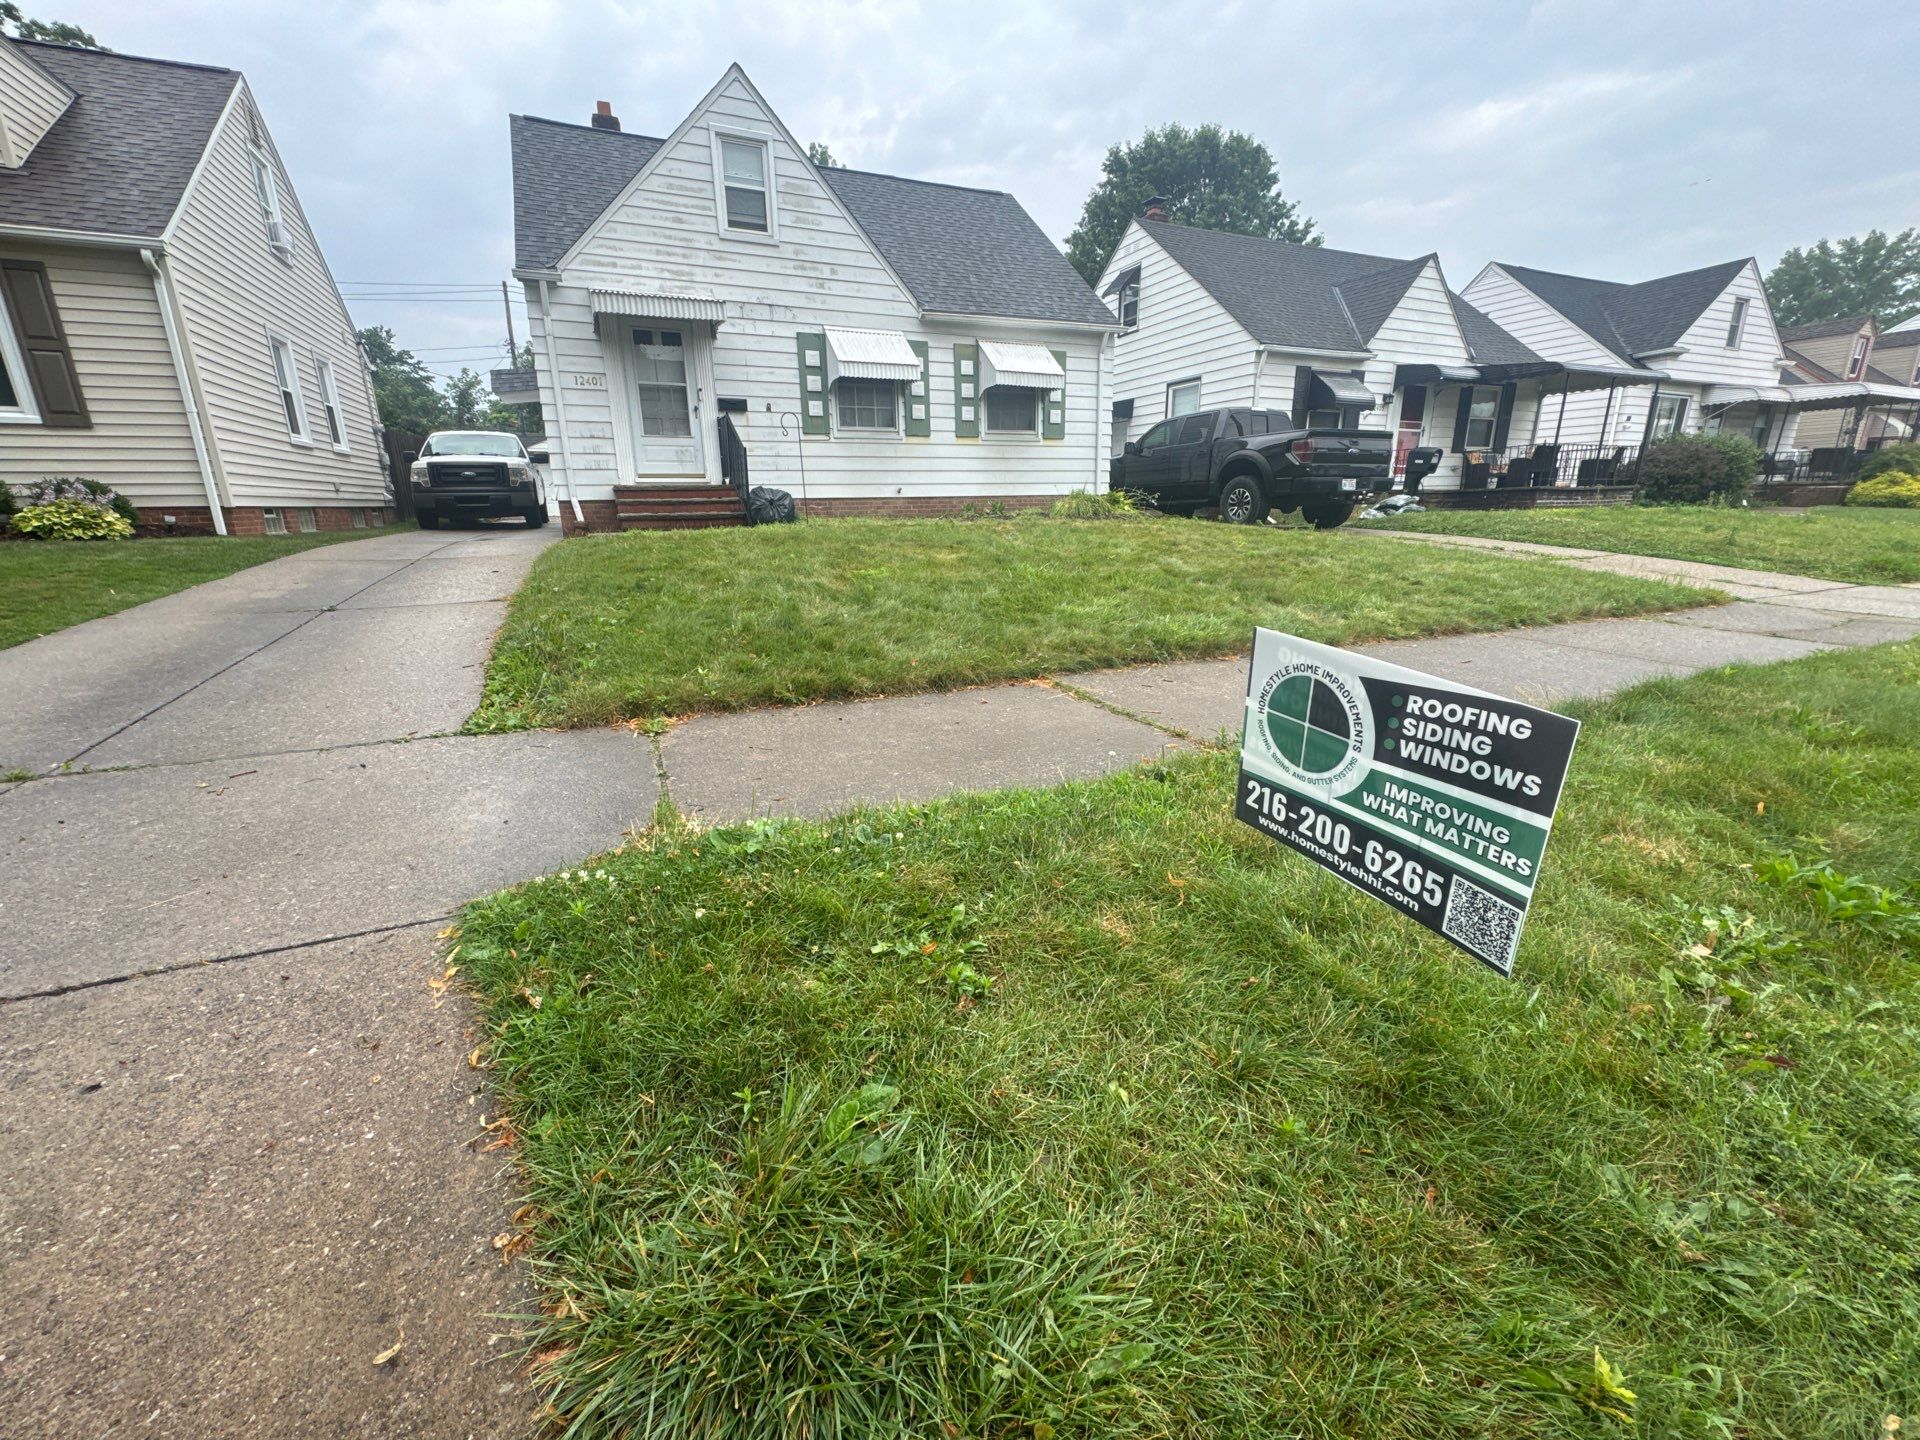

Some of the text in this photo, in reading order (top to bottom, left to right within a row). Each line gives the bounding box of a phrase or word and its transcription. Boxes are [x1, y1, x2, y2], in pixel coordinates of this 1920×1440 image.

[574, 375, 603, 386] 12401
[1258, 663, 1363, 753] HOMESTYLE HOME IMPROVEMENTS
[1402, 717, 1493, 756] SIDING
[1405, 694, 1532, 740] ROOFING
[1291, 771, 1307, 783] AND
[1307, 777, 1334, 786] GUTTER
[1332, 756, 1358, 782] SYSTEMS
[1400, 738, 1542, 796] WINDOWS
[1245, 780, 1445, 907] 216-200-6265
[1362, 790, 1533, 877] WHAT MATTERS
[1383, 781, 1511, 845] IMPROVING
[1258, 815, 1420, 912] www.homestylehhi.com
